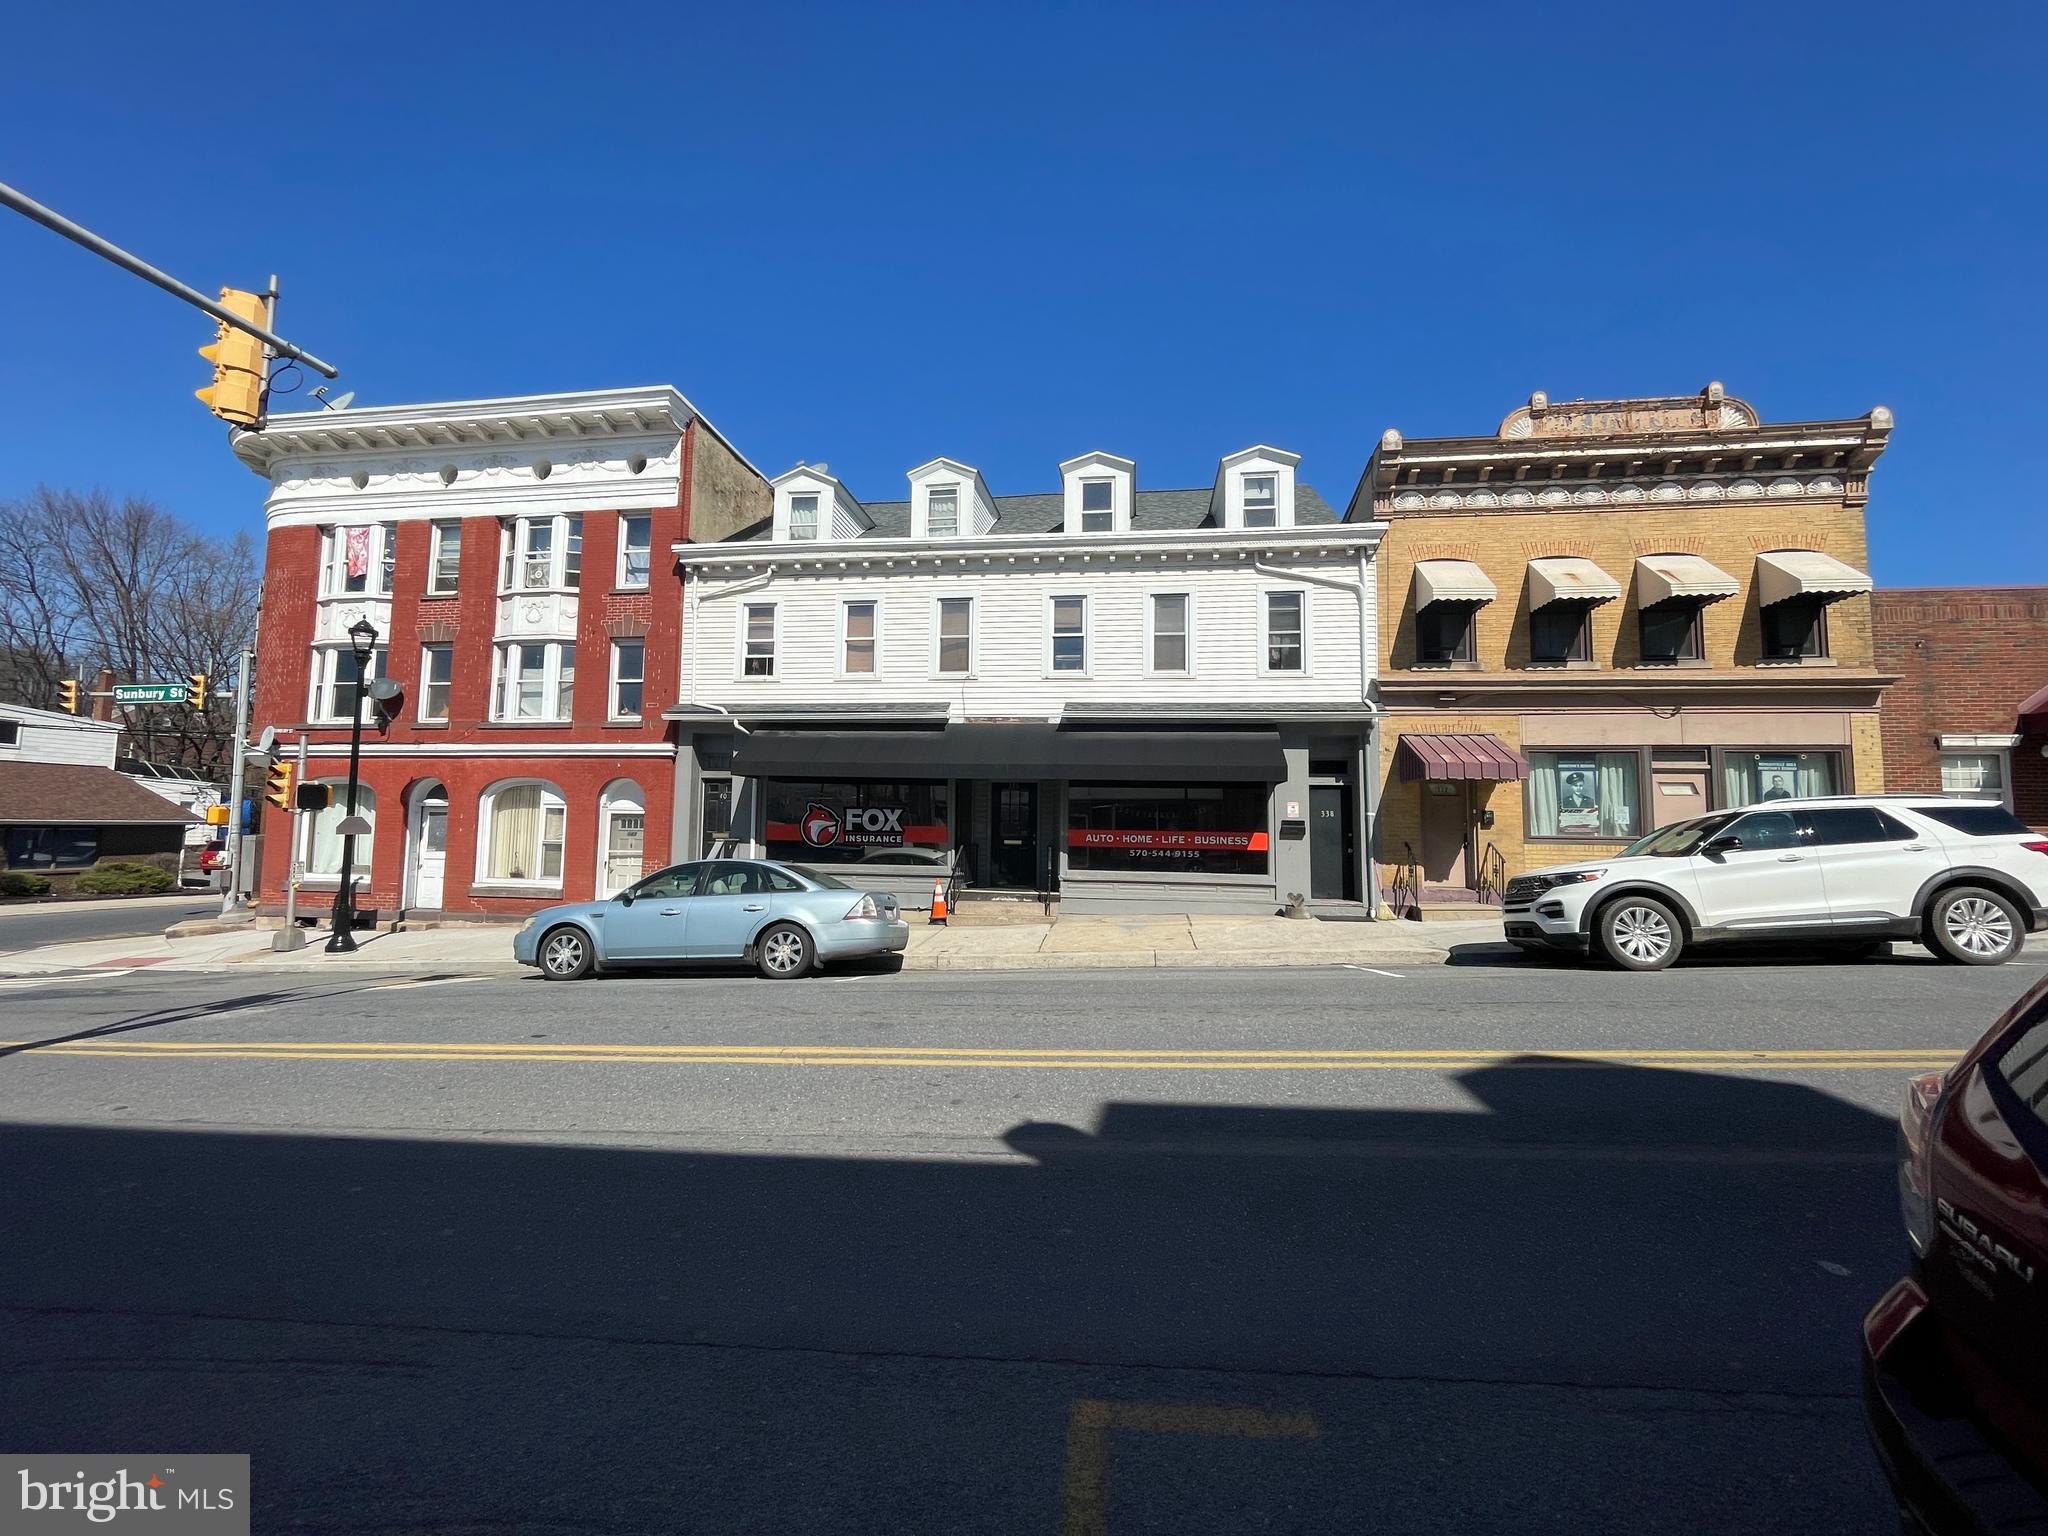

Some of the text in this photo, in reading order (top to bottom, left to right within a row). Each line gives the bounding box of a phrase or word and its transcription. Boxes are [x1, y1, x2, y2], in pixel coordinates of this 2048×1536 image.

[116, 687, 184, 700] Sunbury St
[845, 808, 903, 832] FOX
[1320, 810, 1335, 818] 338
[845, 834, 902, 843] INSURANCE
[1085, 833, 1249, 845] AUTO HOME LIFE BUSINESS
[1129, 849, 1200, 858] 570-544-9155
[1937, 1196, 2034, 1283] SUBARU
